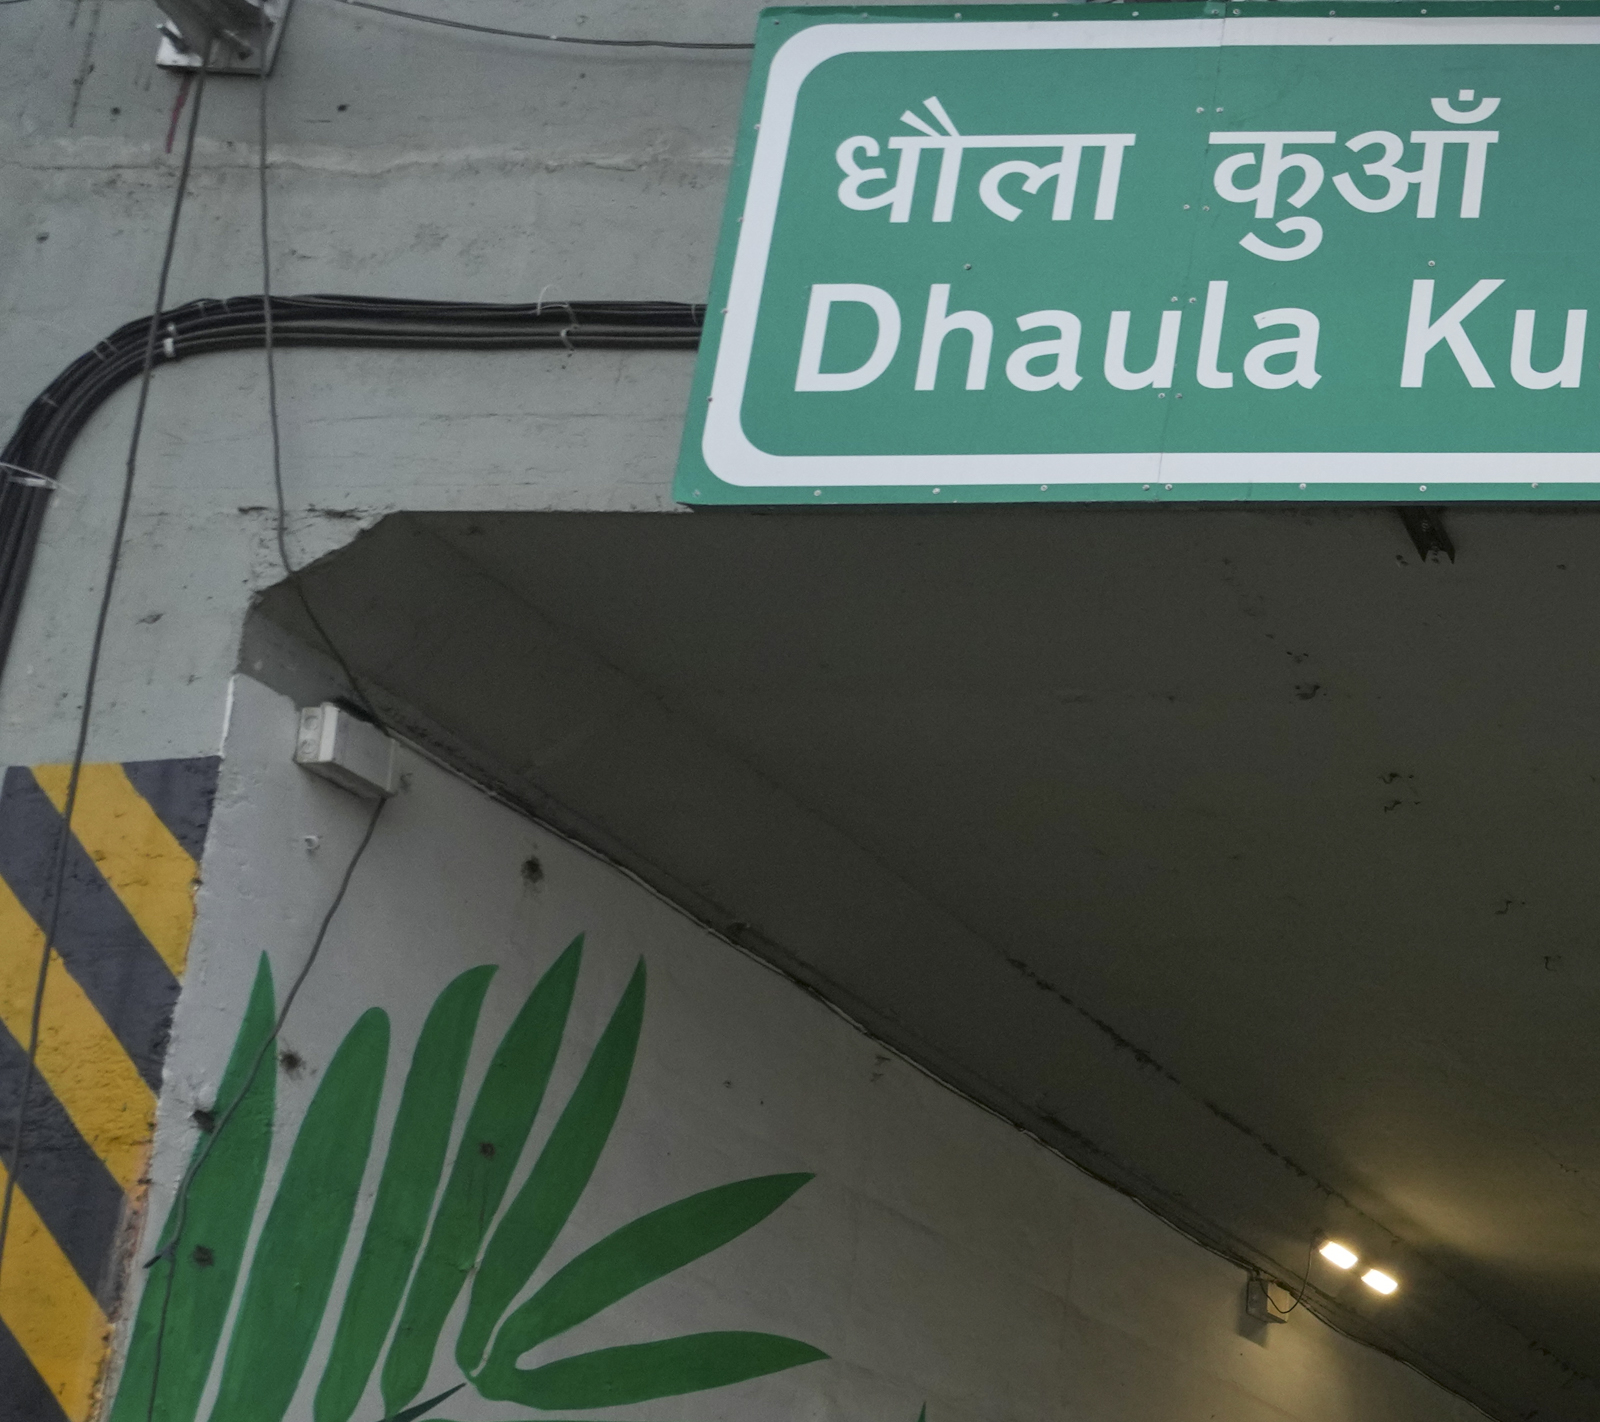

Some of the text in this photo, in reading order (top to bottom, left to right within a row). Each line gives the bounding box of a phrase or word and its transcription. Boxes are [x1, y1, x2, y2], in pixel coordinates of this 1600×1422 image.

[835, 89, 1501, 262] धौला कुआँ
[794, 280, 1322, 392] Dhaula
